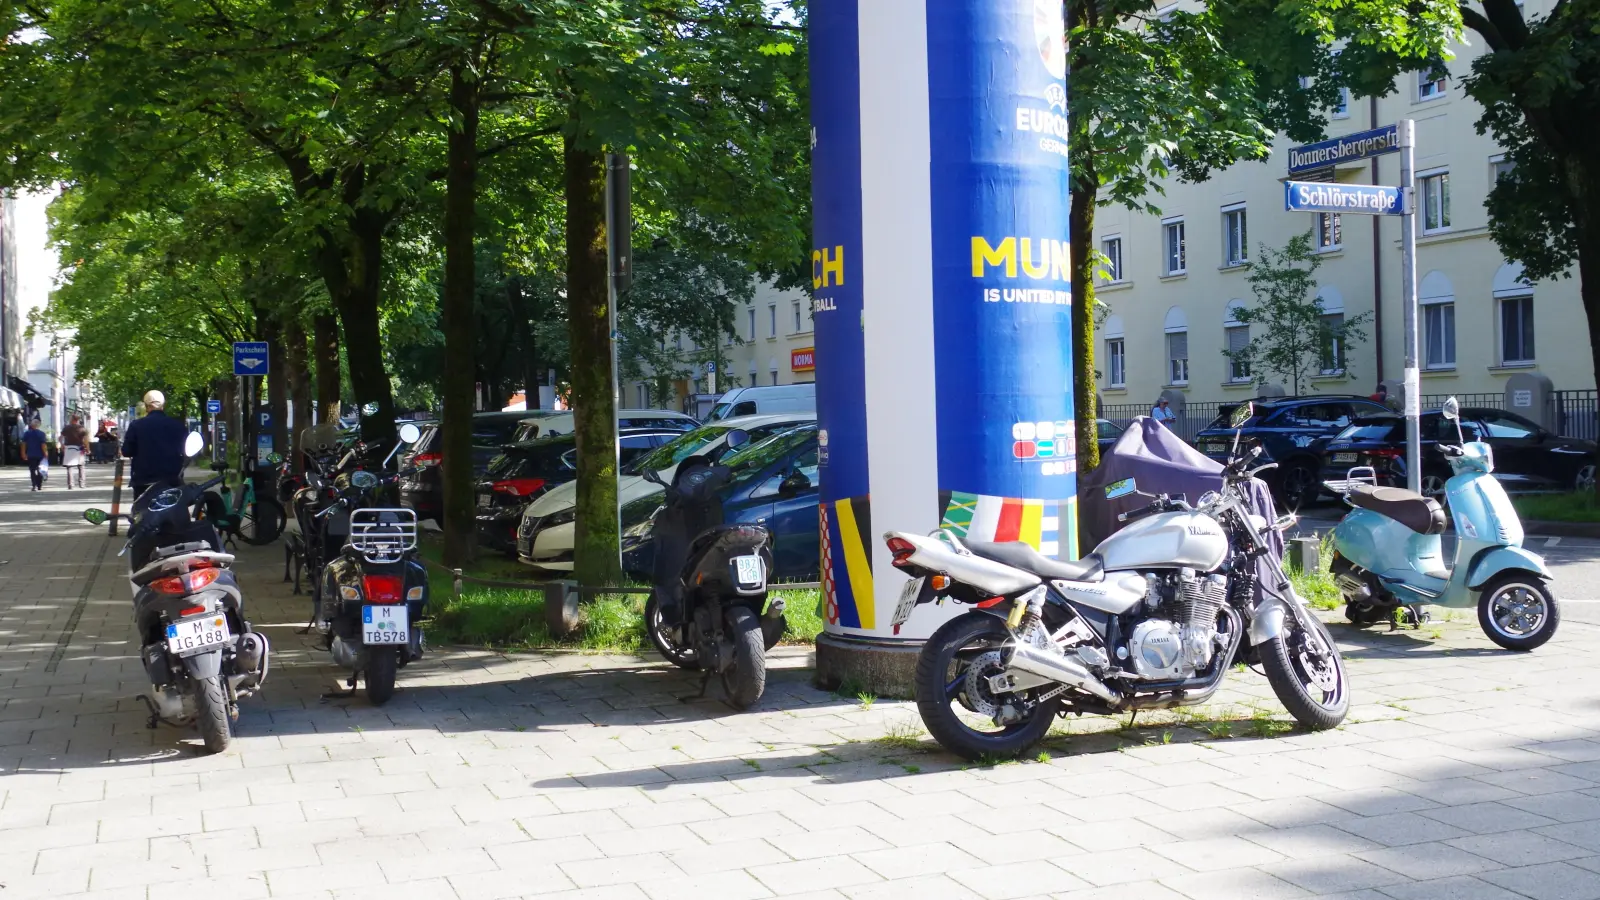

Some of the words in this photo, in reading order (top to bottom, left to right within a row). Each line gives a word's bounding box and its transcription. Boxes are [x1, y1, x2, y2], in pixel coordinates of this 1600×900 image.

[1299, 185, 1396, 212] Schlörstraße
[971, 236, 1071, 282] MUN
[812, 245, 844, 289] CH
[984, 289, 1000, 302] IS
[1003, 289, 1055, 304] UNITED
[261, 412, 270, 426] P
[382, 607, 391, 618] M
[193, 621, 203, 633] M
